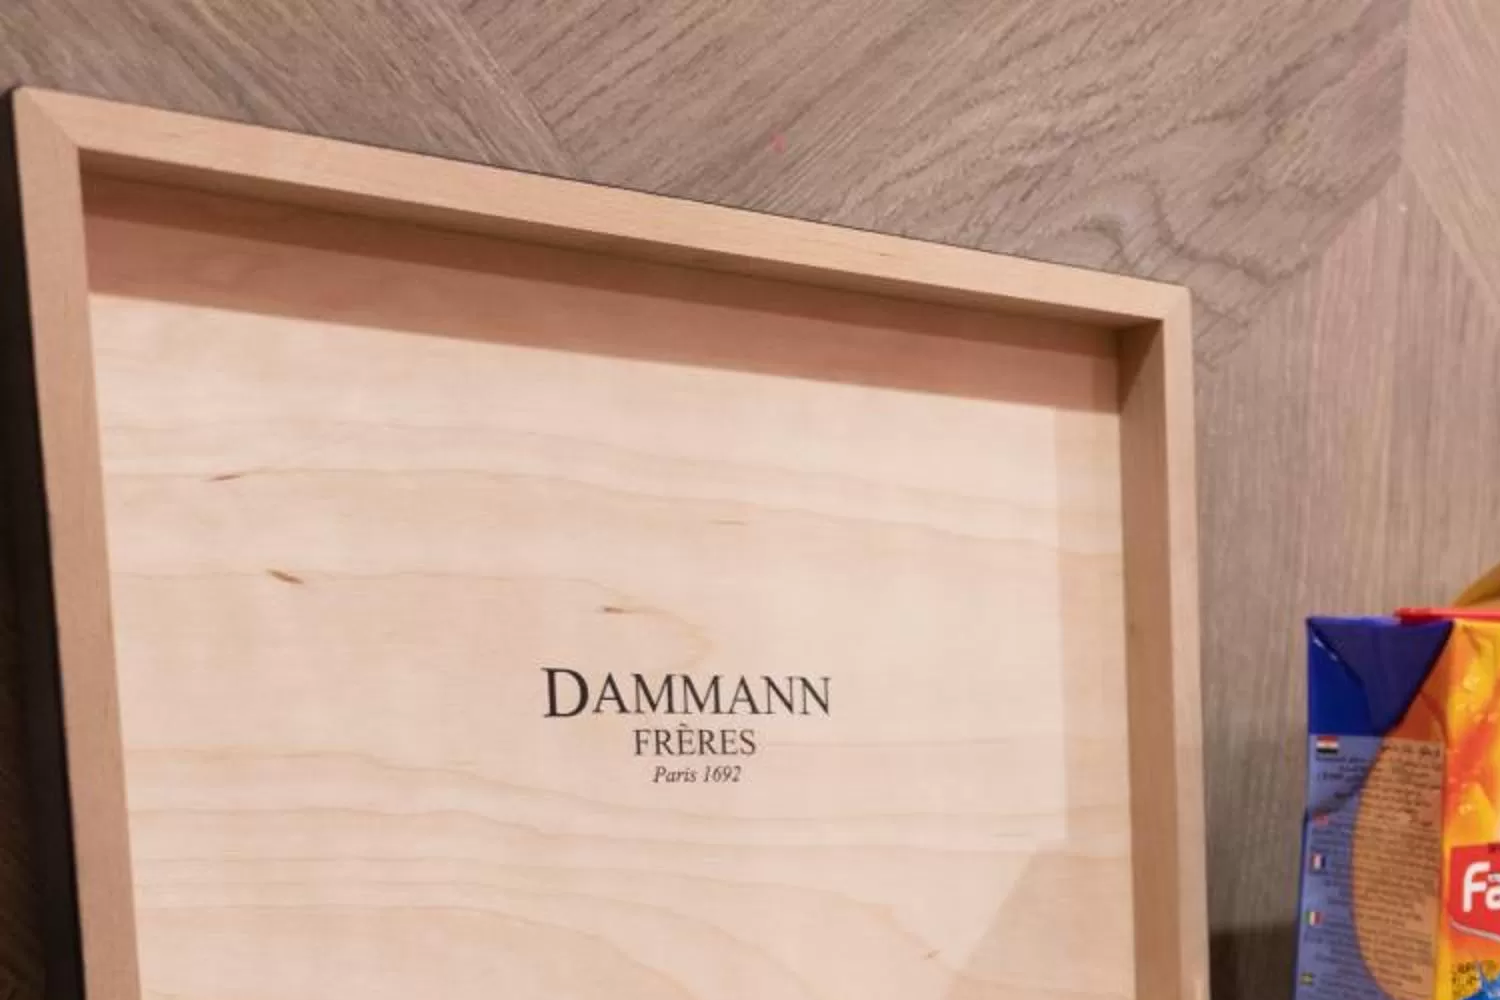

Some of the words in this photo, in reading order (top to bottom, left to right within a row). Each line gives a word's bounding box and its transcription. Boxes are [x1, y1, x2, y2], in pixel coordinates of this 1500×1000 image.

[541, 666, 832, 718] DAMMANN
[633, 723, 757, 757] FRÈRES
[652, 766, 697, 783] Paris
[702, 764, 742, 783] 1692
